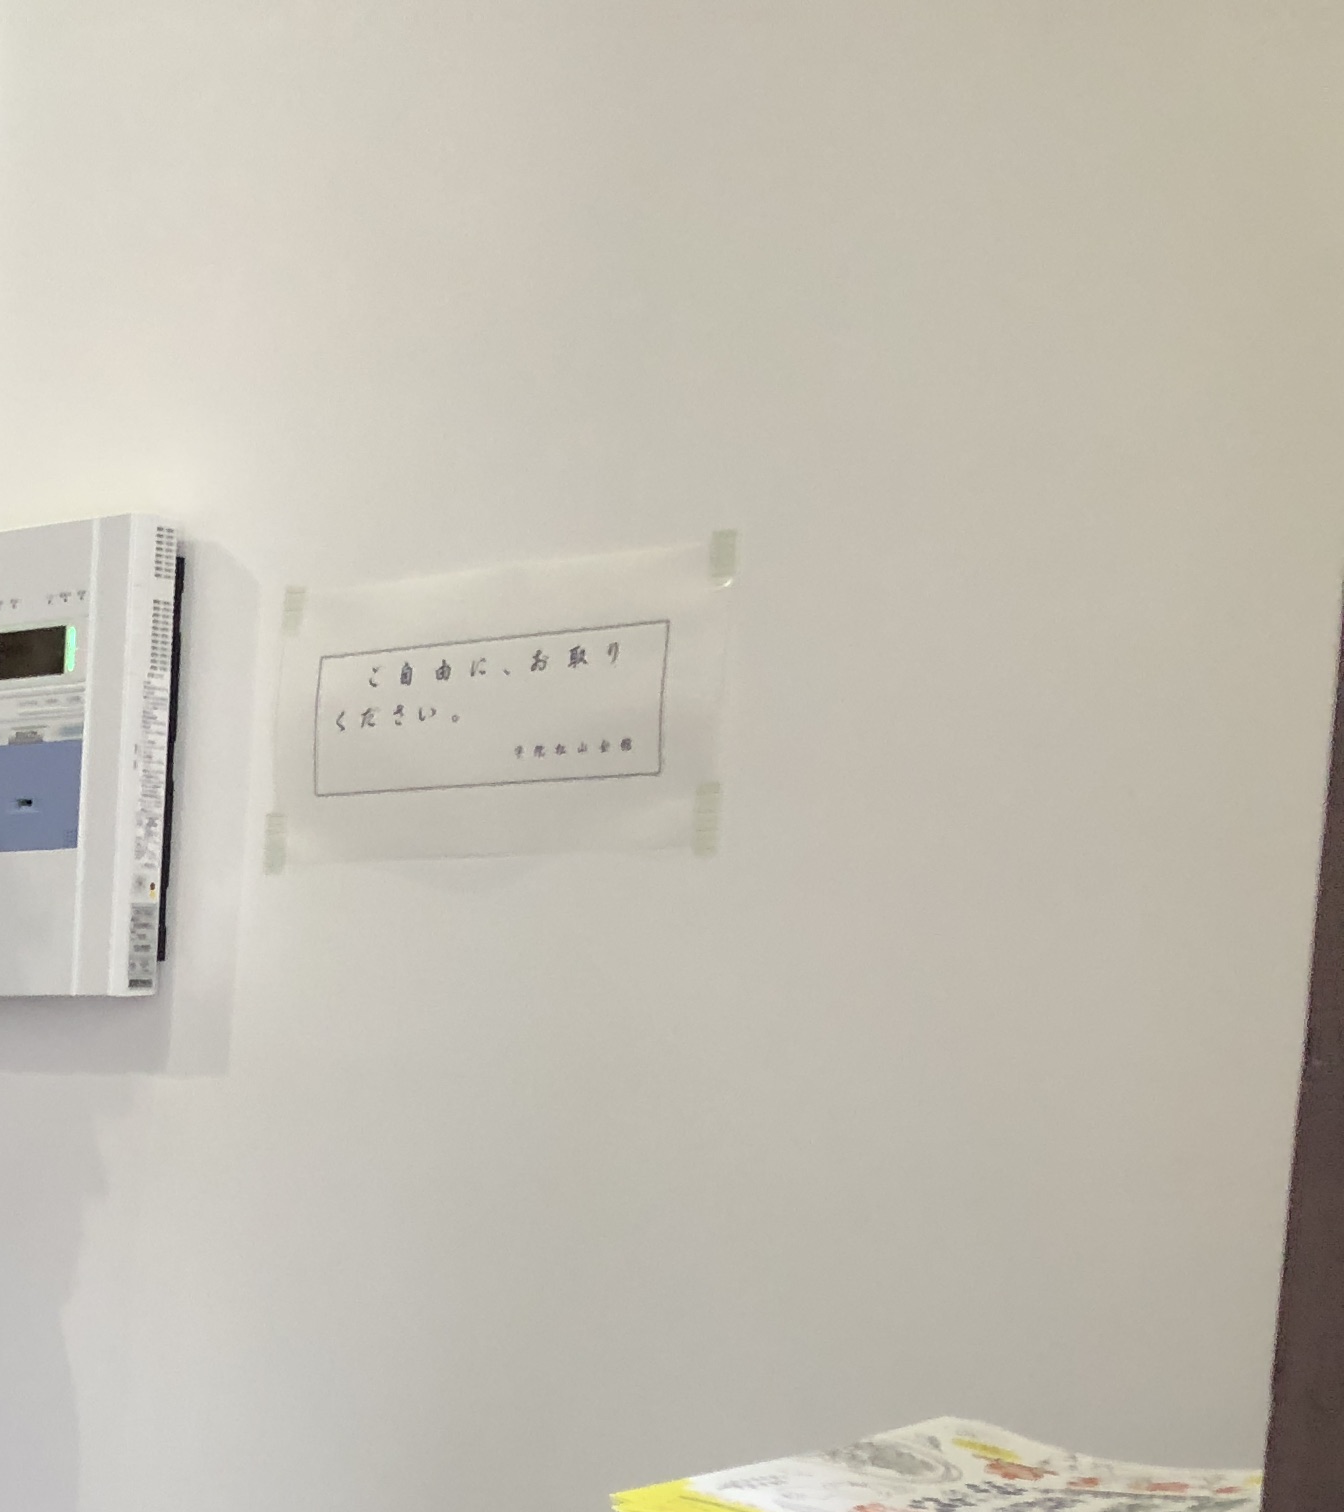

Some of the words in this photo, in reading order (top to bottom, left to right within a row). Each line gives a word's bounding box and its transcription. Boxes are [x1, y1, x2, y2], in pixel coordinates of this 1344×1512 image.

[368, 641, 620, 688] ご自由に、お取り
[334, 704, 461, 733] ください。
